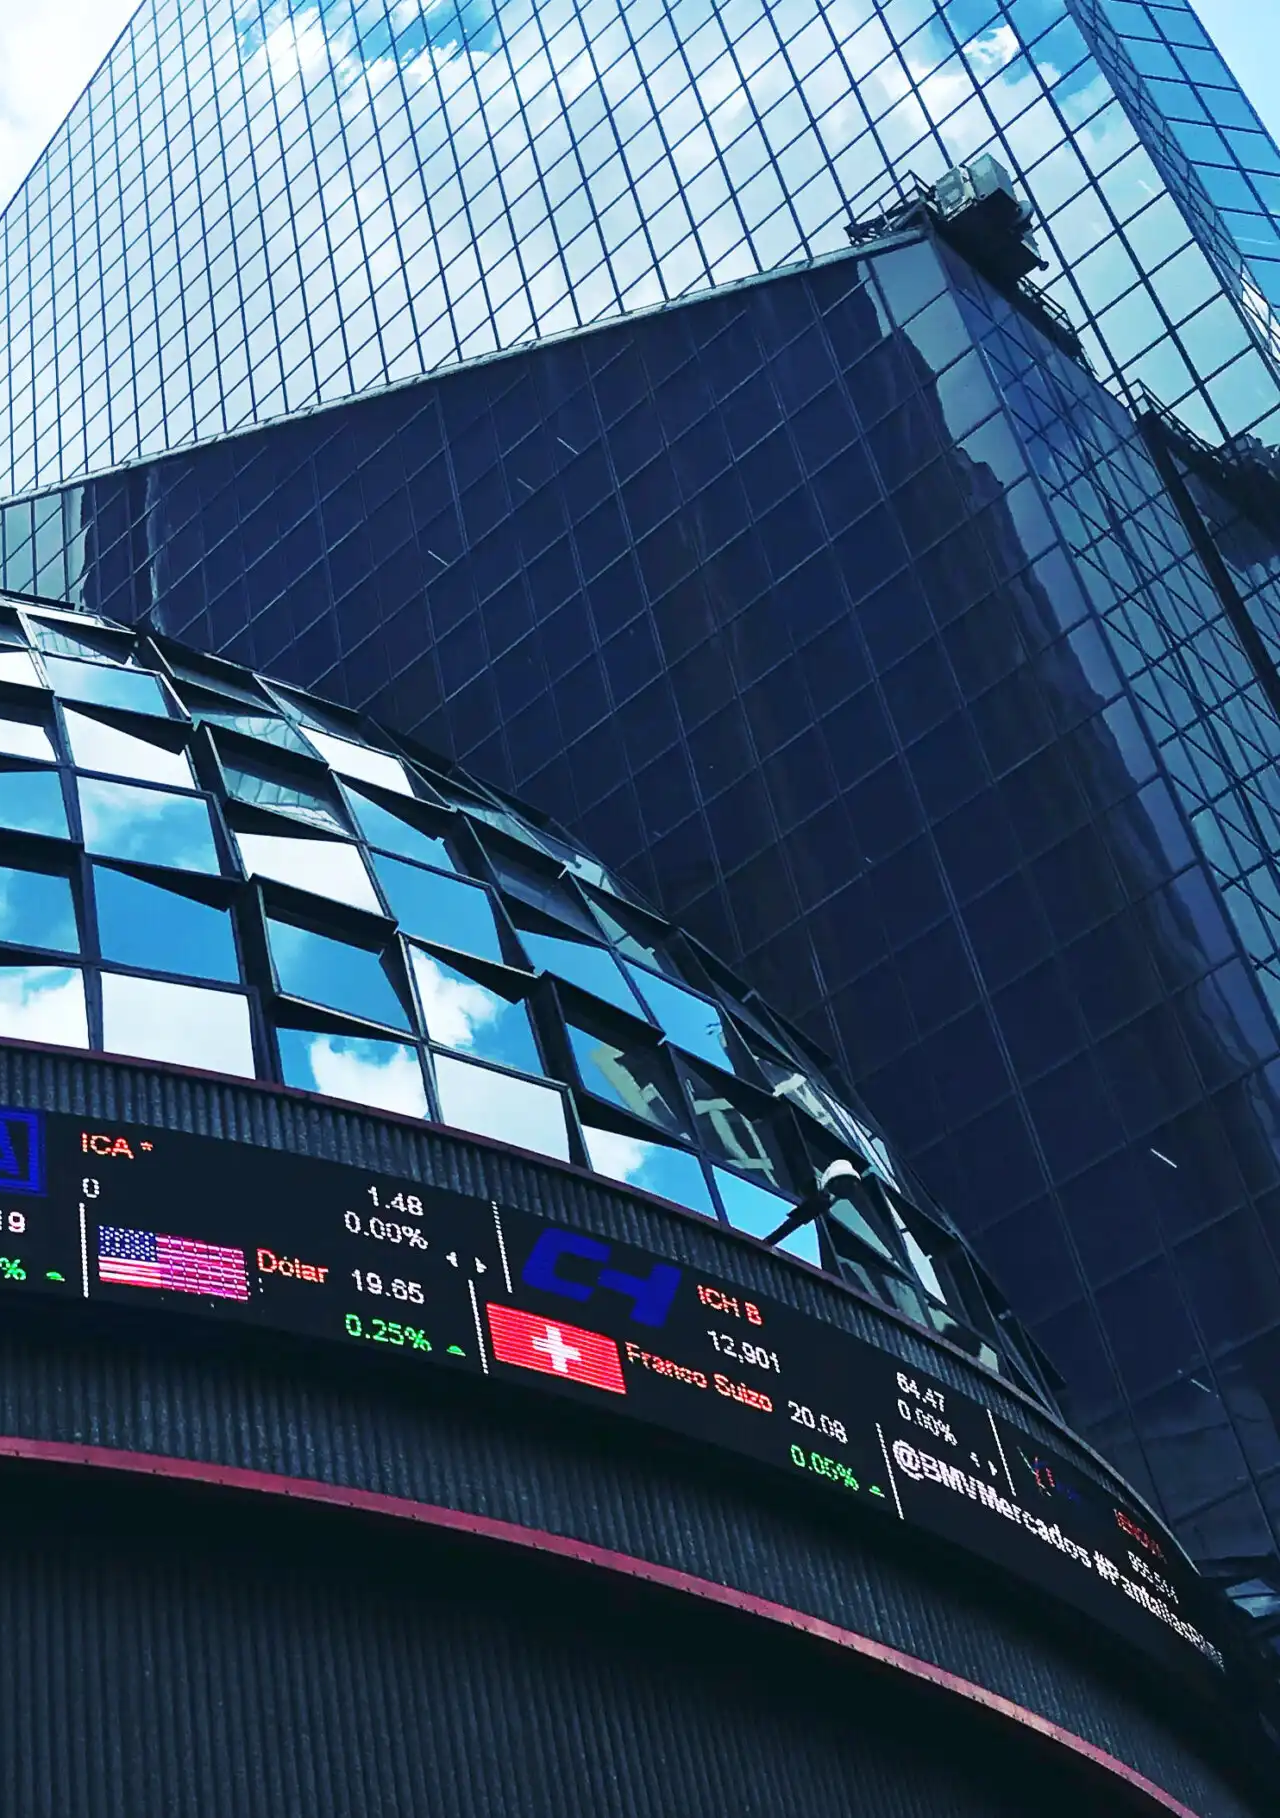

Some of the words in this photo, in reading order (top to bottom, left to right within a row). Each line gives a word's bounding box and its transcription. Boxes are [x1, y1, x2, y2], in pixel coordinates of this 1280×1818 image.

[81, 1132, 134, 1160] ICA
[82, 1178, 100, 1198] 0
[368, 1185, 424, 1216] 1.48
[344, 1210, 429, 1250] 0.00%
[351, 1269, 425, 1304] 19.65
[696, 1285, 740, 1318] ICH
[744, 1301, 763, 1326] B
[344, 1313, 433, 1352] 0.25%
[707, 1330, 780, 1374] 12,901
[713, 1372, 773, 1412] Suizo
[790, 1444, 859, 1491] 0.05%
